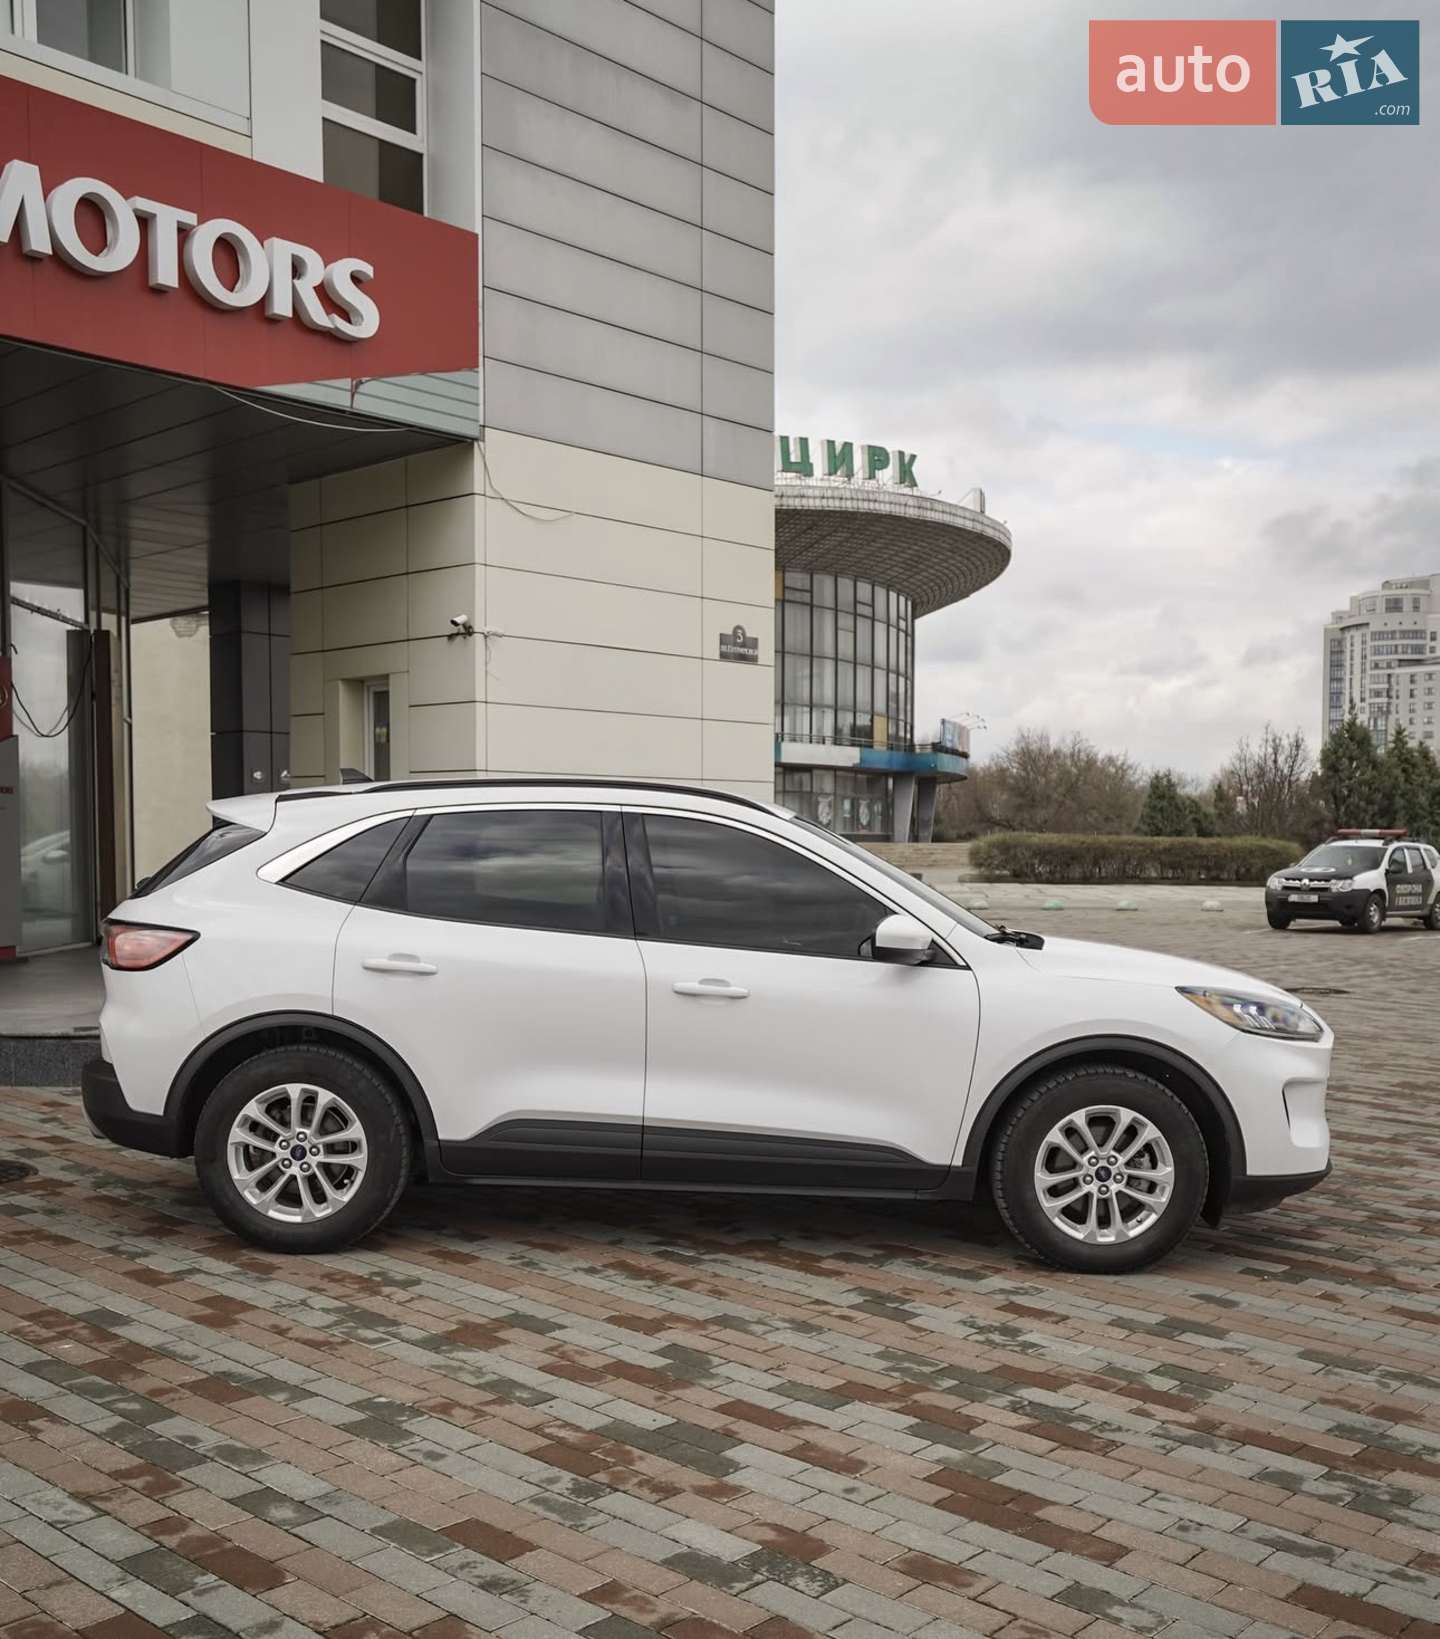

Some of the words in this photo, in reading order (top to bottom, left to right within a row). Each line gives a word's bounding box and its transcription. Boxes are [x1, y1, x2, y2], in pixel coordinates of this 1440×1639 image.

[0, 158, 381, 342] MOTORS
[777, 435, 919, 488] ЦИРК
[736, 629, 744, 643] 3
